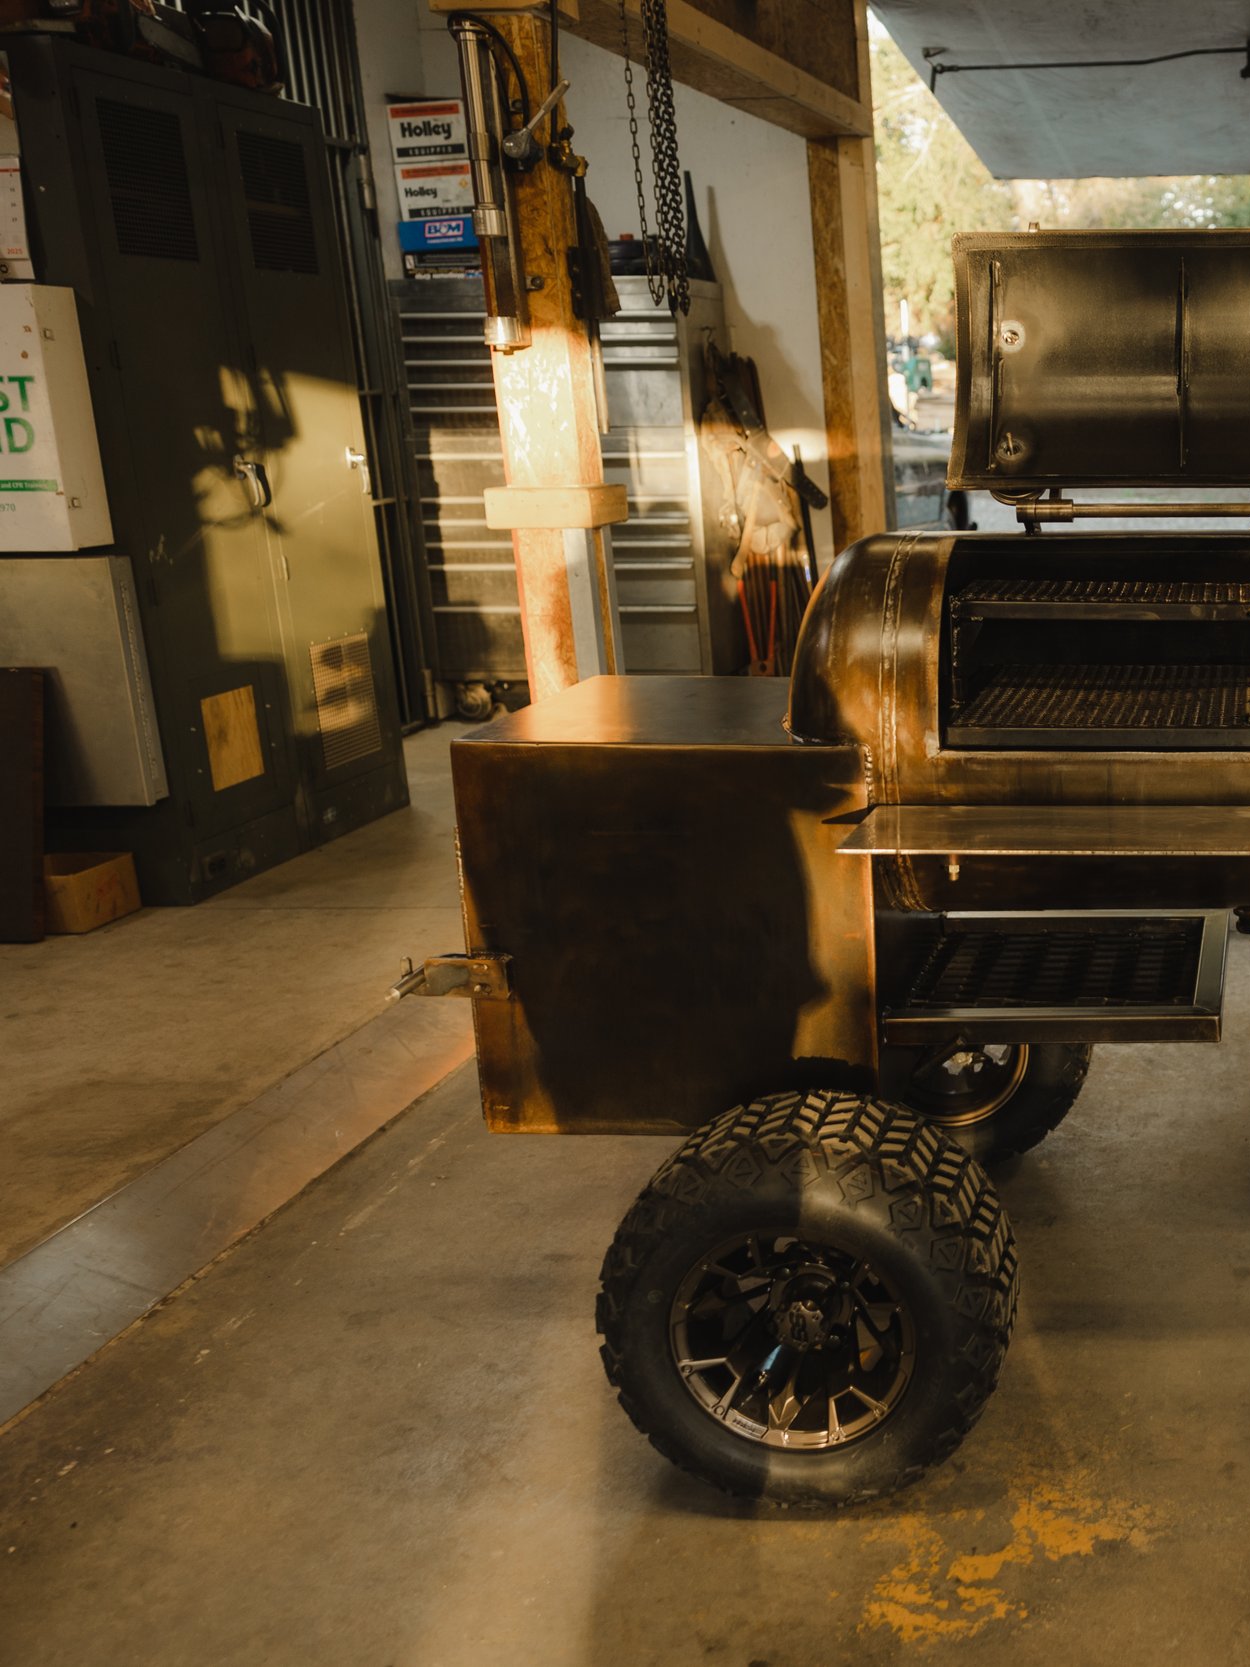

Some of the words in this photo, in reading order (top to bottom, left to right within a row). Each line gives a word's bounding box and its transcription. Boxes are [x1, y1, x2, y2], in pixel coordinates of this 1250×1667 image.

[400, 120, 452, 140] Holley
[408, 146, 452, 156] EQUIPPED
[404, 186, 438, 198] Holley
